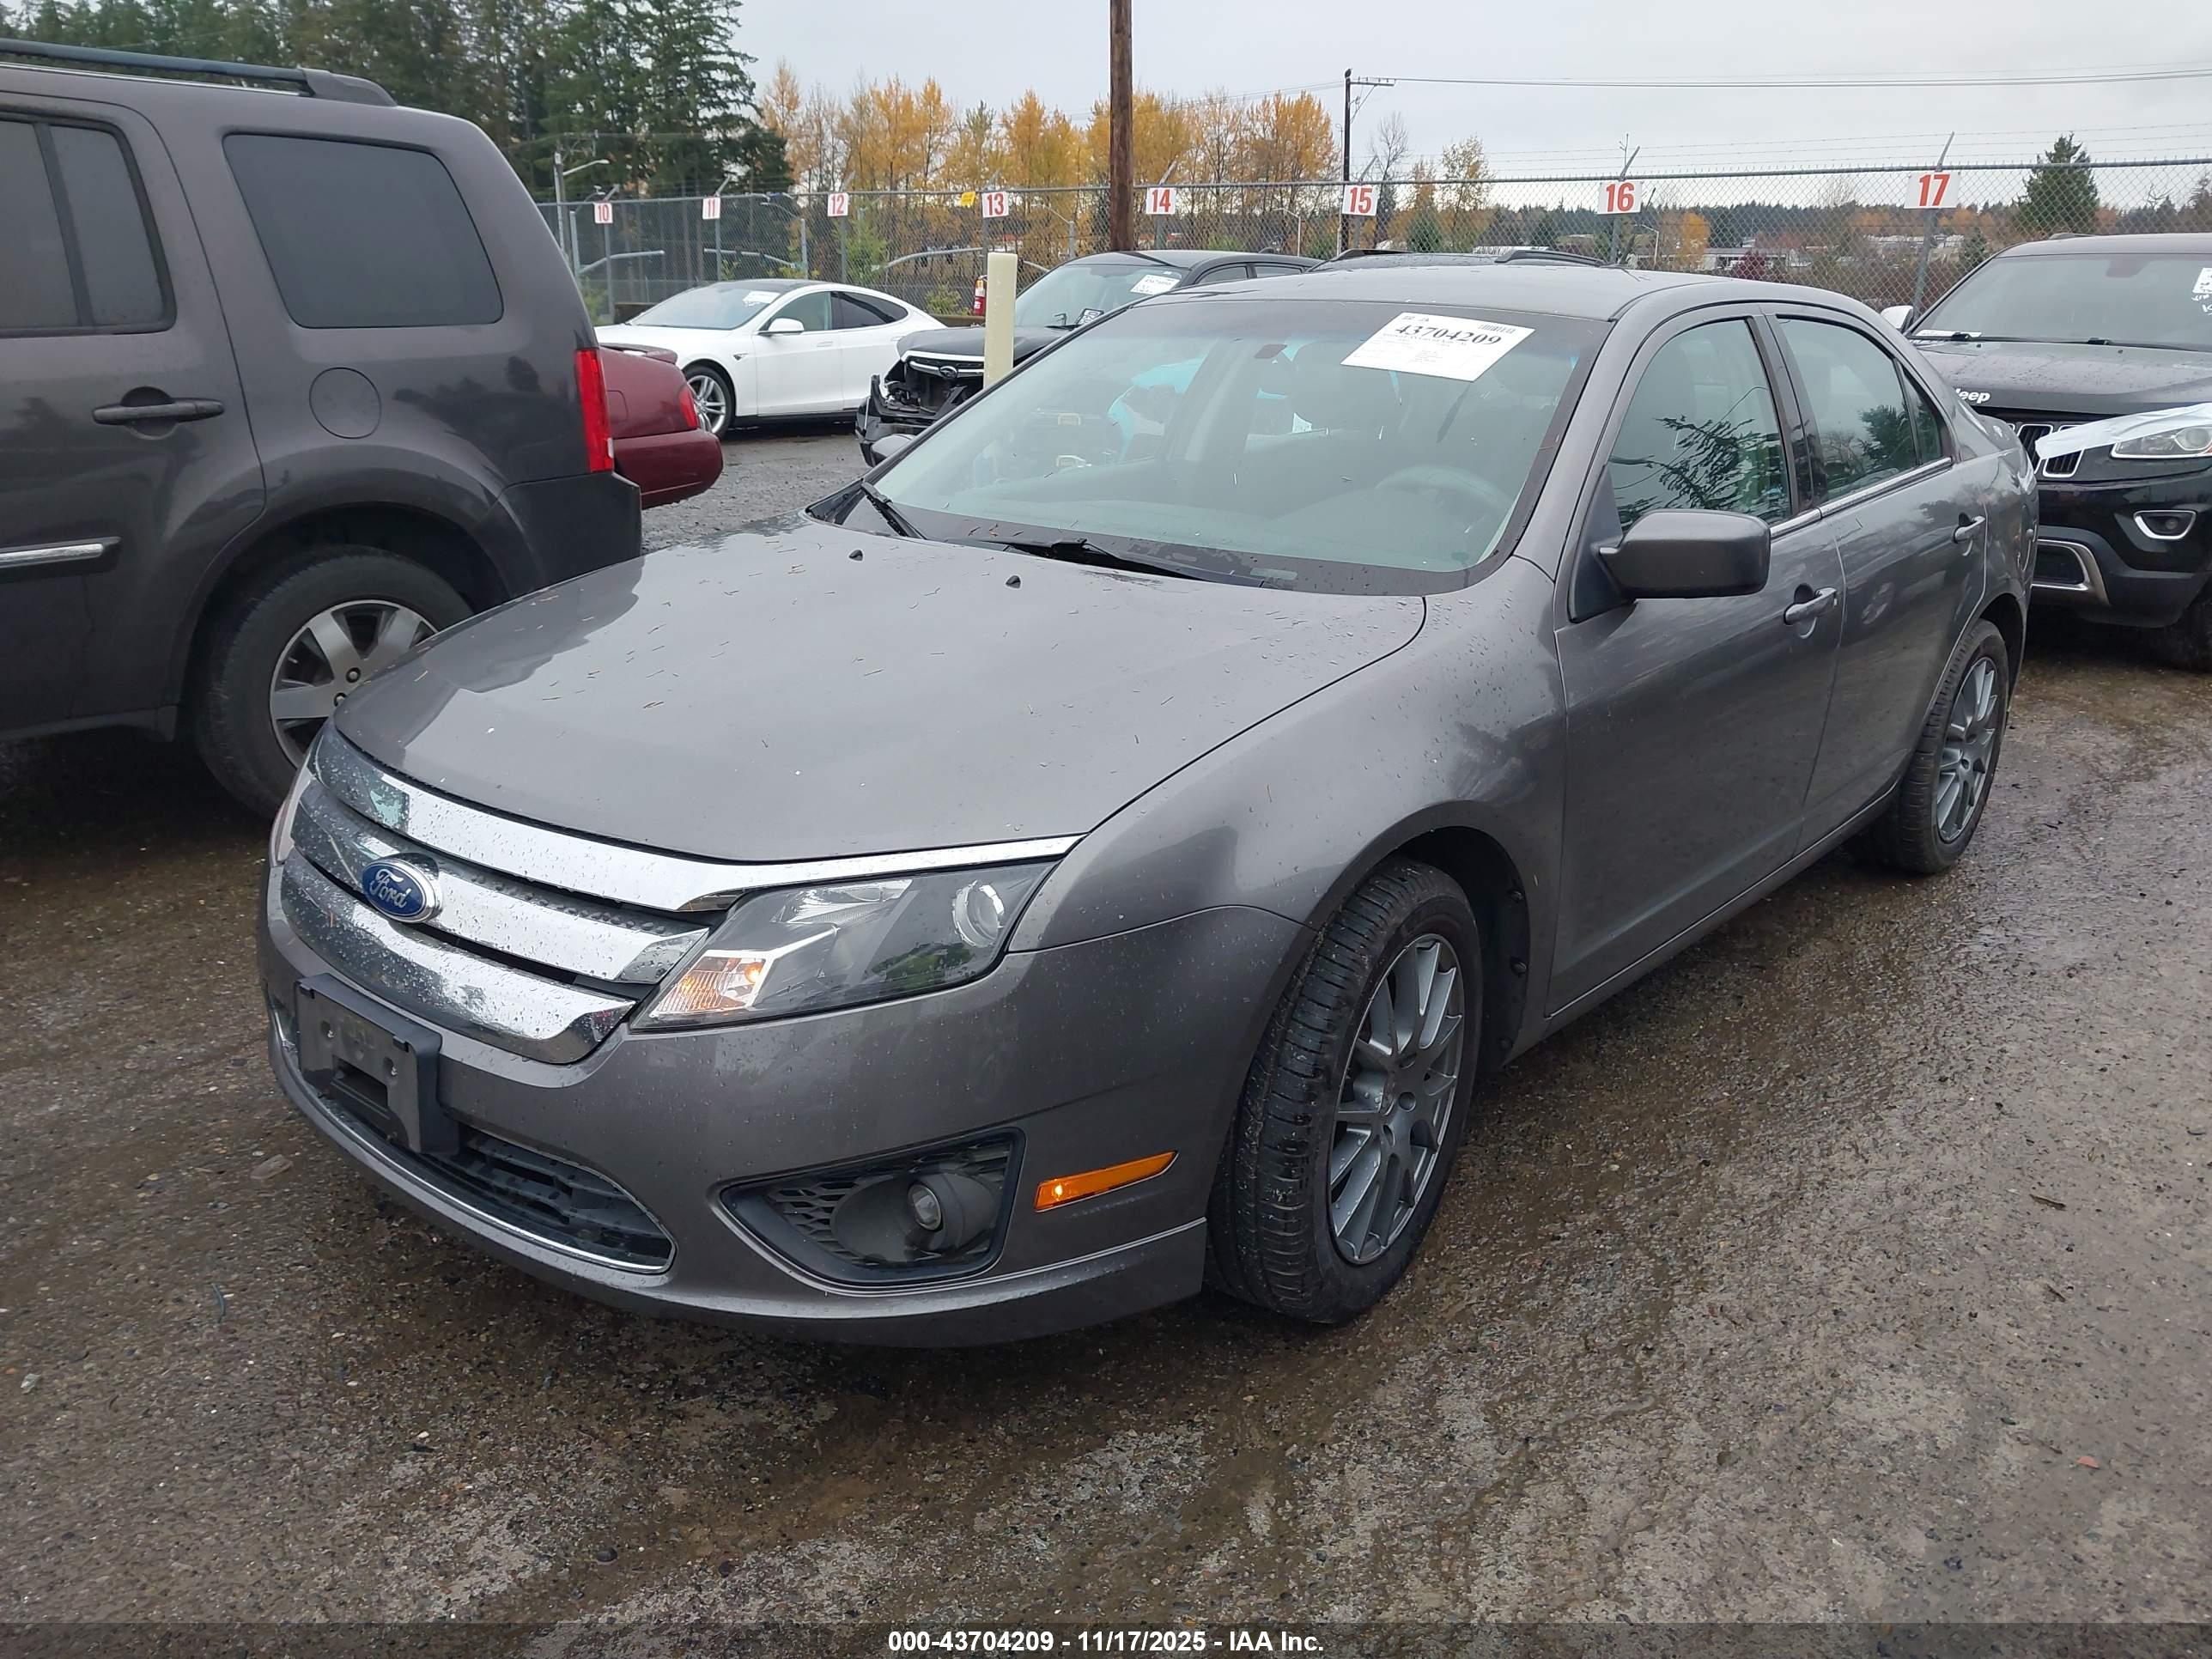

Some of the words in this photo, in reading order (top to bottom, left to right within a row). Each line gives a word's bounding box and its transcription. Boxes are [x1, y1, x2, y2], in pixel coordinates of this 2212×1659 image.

[1152, 188, 1172, 213] 14
[1349, 187, 1373, 214] 15
[1606, 182, 1635, 212] 16
[1918, 173, 1951, 207] 17
[598, 204, 610, 221] 10
[707, 198, 715, 218] 11
[831, 193, 845, 215] 12
[987, 192, 1005, 216] 13
[1395, 325, 1502, 345] 43704209
[369, 868, 412, 908] Ford
